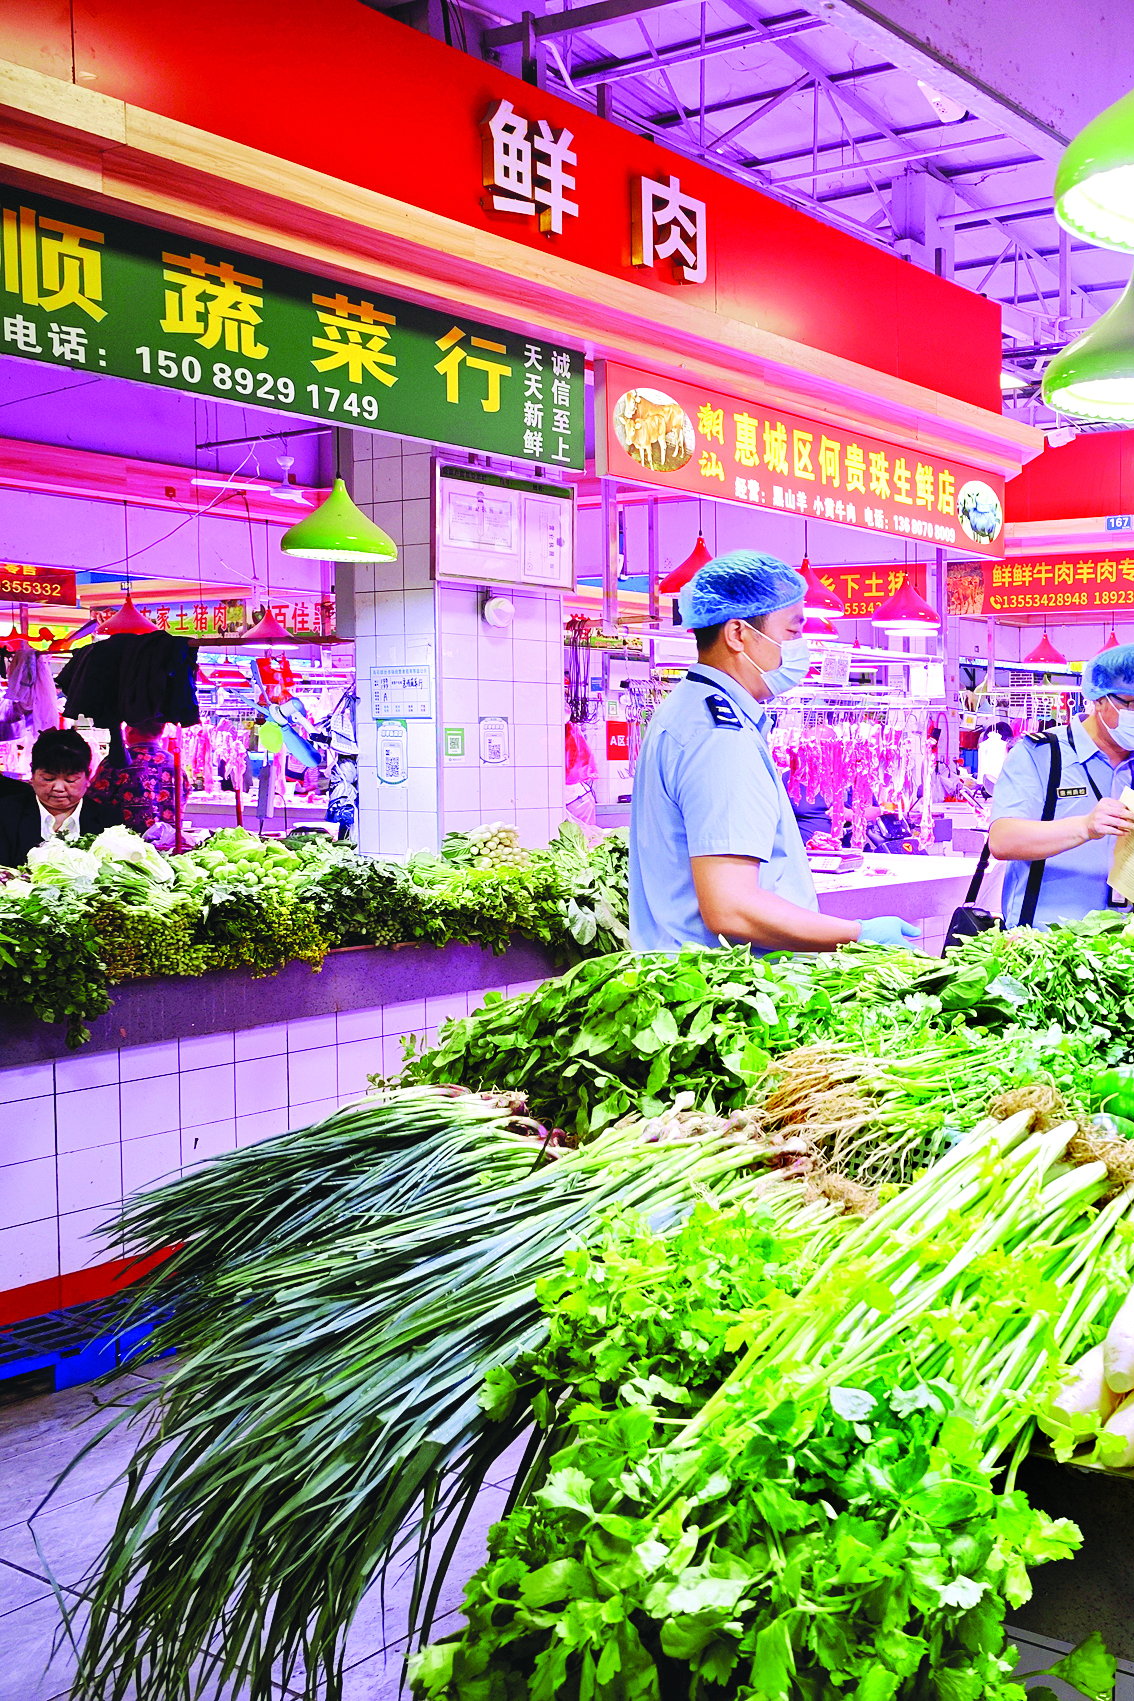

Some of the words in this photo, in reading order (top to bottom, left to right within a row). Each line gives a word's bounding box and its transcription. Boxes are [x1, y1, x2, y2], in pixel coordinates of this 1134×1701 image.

[488, 99, 707, 284] 鲜肉
[0, 205, 512, 413] 顺蔬菜行
[135, 346, 201, 384] 150
[212, 362, 295, 404] 8929
[306, 384, 379, 421] 1749
[523, 343, 544, 458] 天天新鲜
[551, 350, 572, 463] 诚信至上
[697, 402, 725, 482] 潮汕
[733, 412, 955, 516] 惠城区何贵珠生鲜店
[1109, 517, 1129, 528] 167
[2, 580, 61, 597] 355332
[1002, 592, 1088, 609] 13553428948
